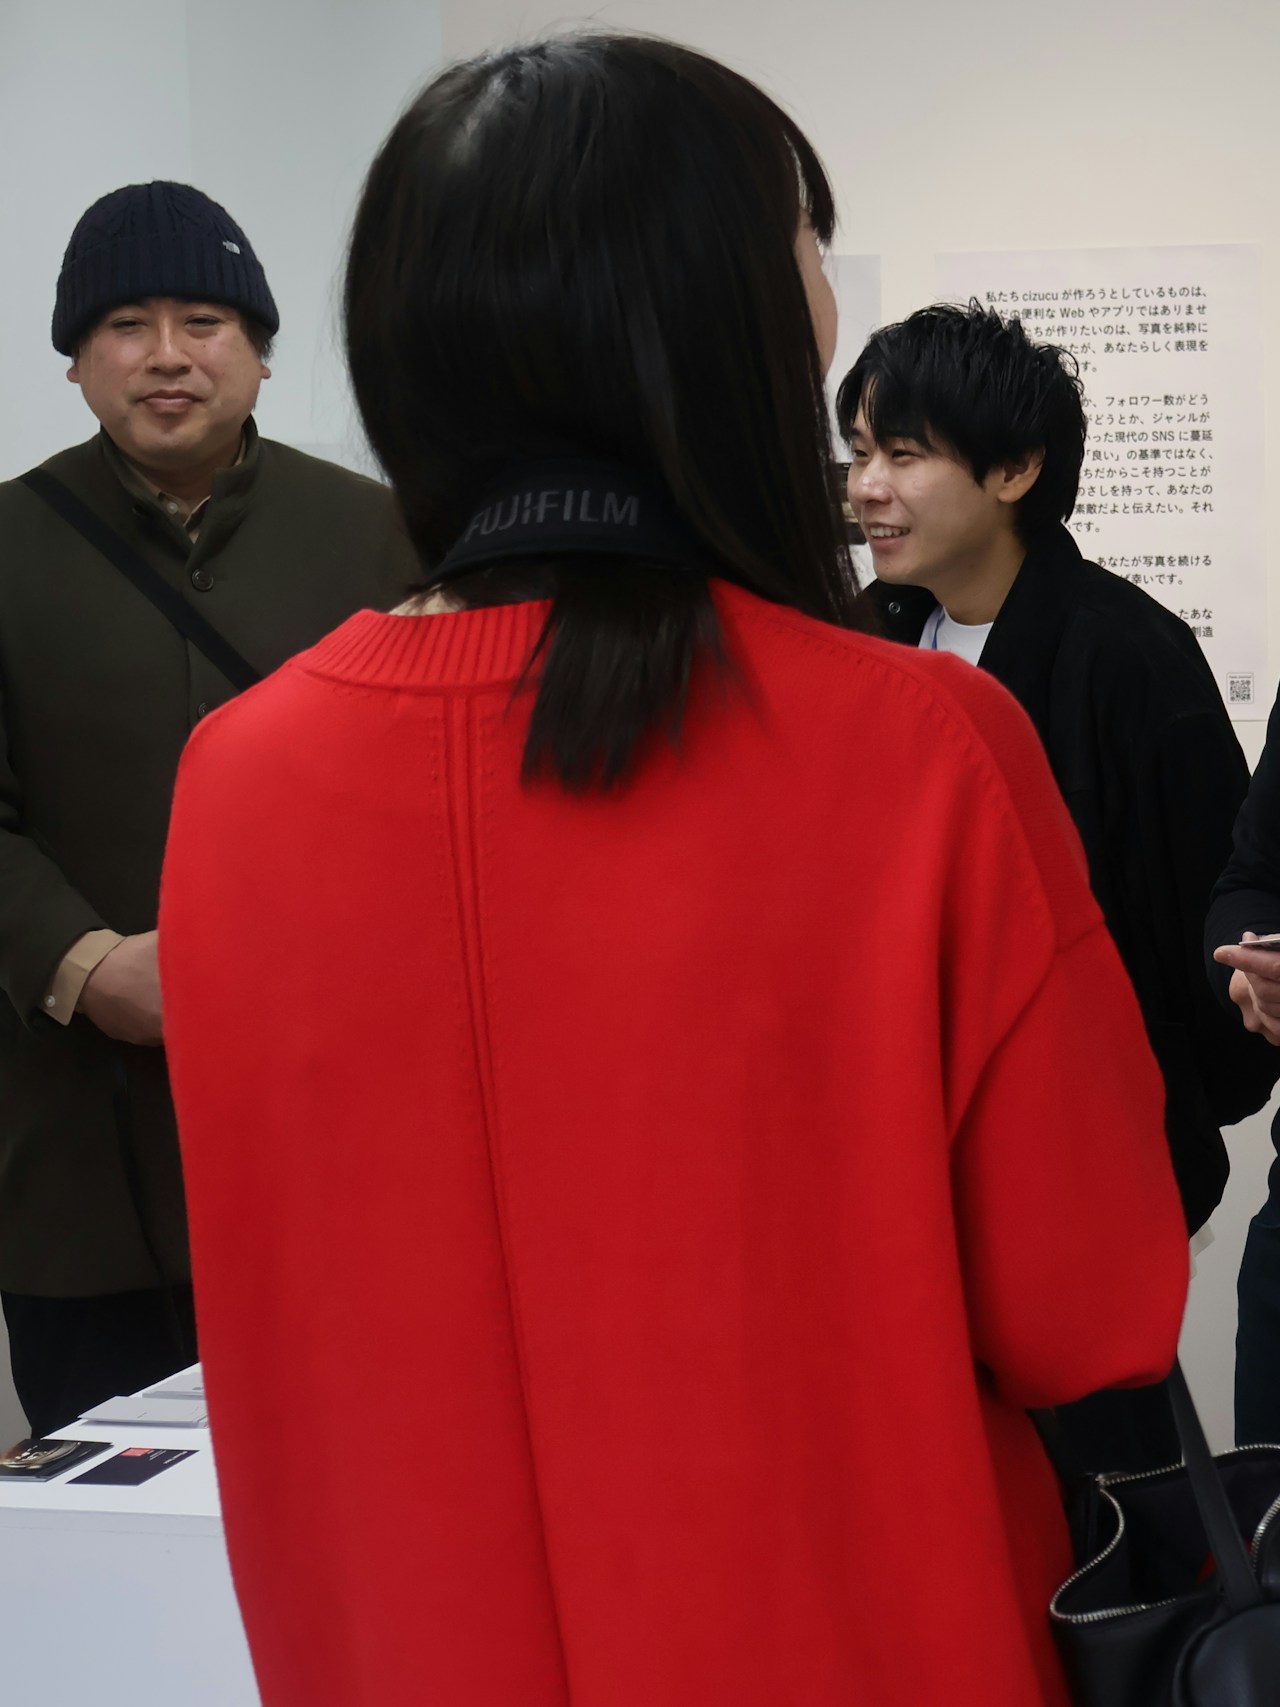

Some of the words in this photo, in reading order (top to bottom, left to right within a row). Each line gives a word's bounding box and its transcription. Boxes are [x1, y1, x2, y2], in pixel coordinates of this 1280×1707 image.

[1022, 290, 1059, 301] cizucu
[1060, 307, 1085, 319] Web
[1151, 431, 1175, 441] SNS
[1081, 465, 1211, 479] ちだからこそ持つことが
[463, 490, 640, 542] FUJIFILM
